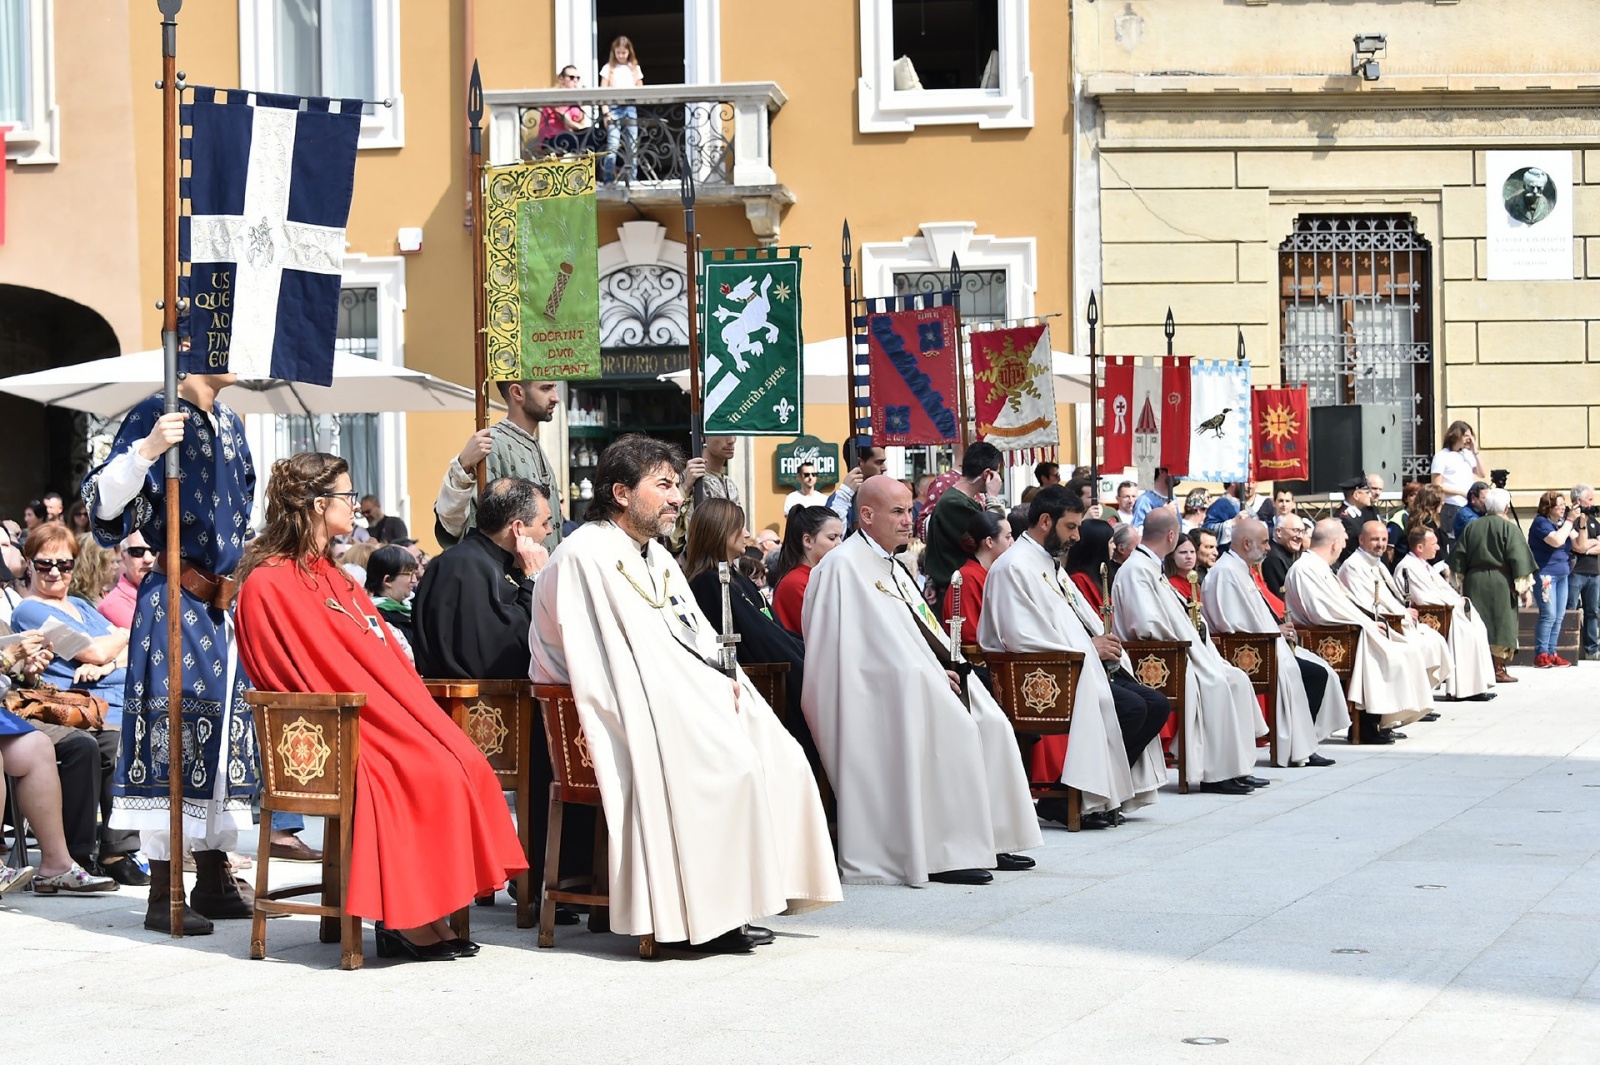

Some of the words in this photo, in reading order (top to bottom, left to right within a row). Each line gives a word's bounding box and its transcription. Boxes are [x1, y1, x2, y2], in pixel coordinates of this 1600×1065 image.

[211, 272, 230, 289] US
[195, 291, 230, 310] QUE
[207, 331, 230, 351] FIN
[531, 329, 584, 343] ODERINT
[727, 412, 742, 424] in
[764, 365, 787, 390] spes
[781, 456, 835, 474] FARACIA
